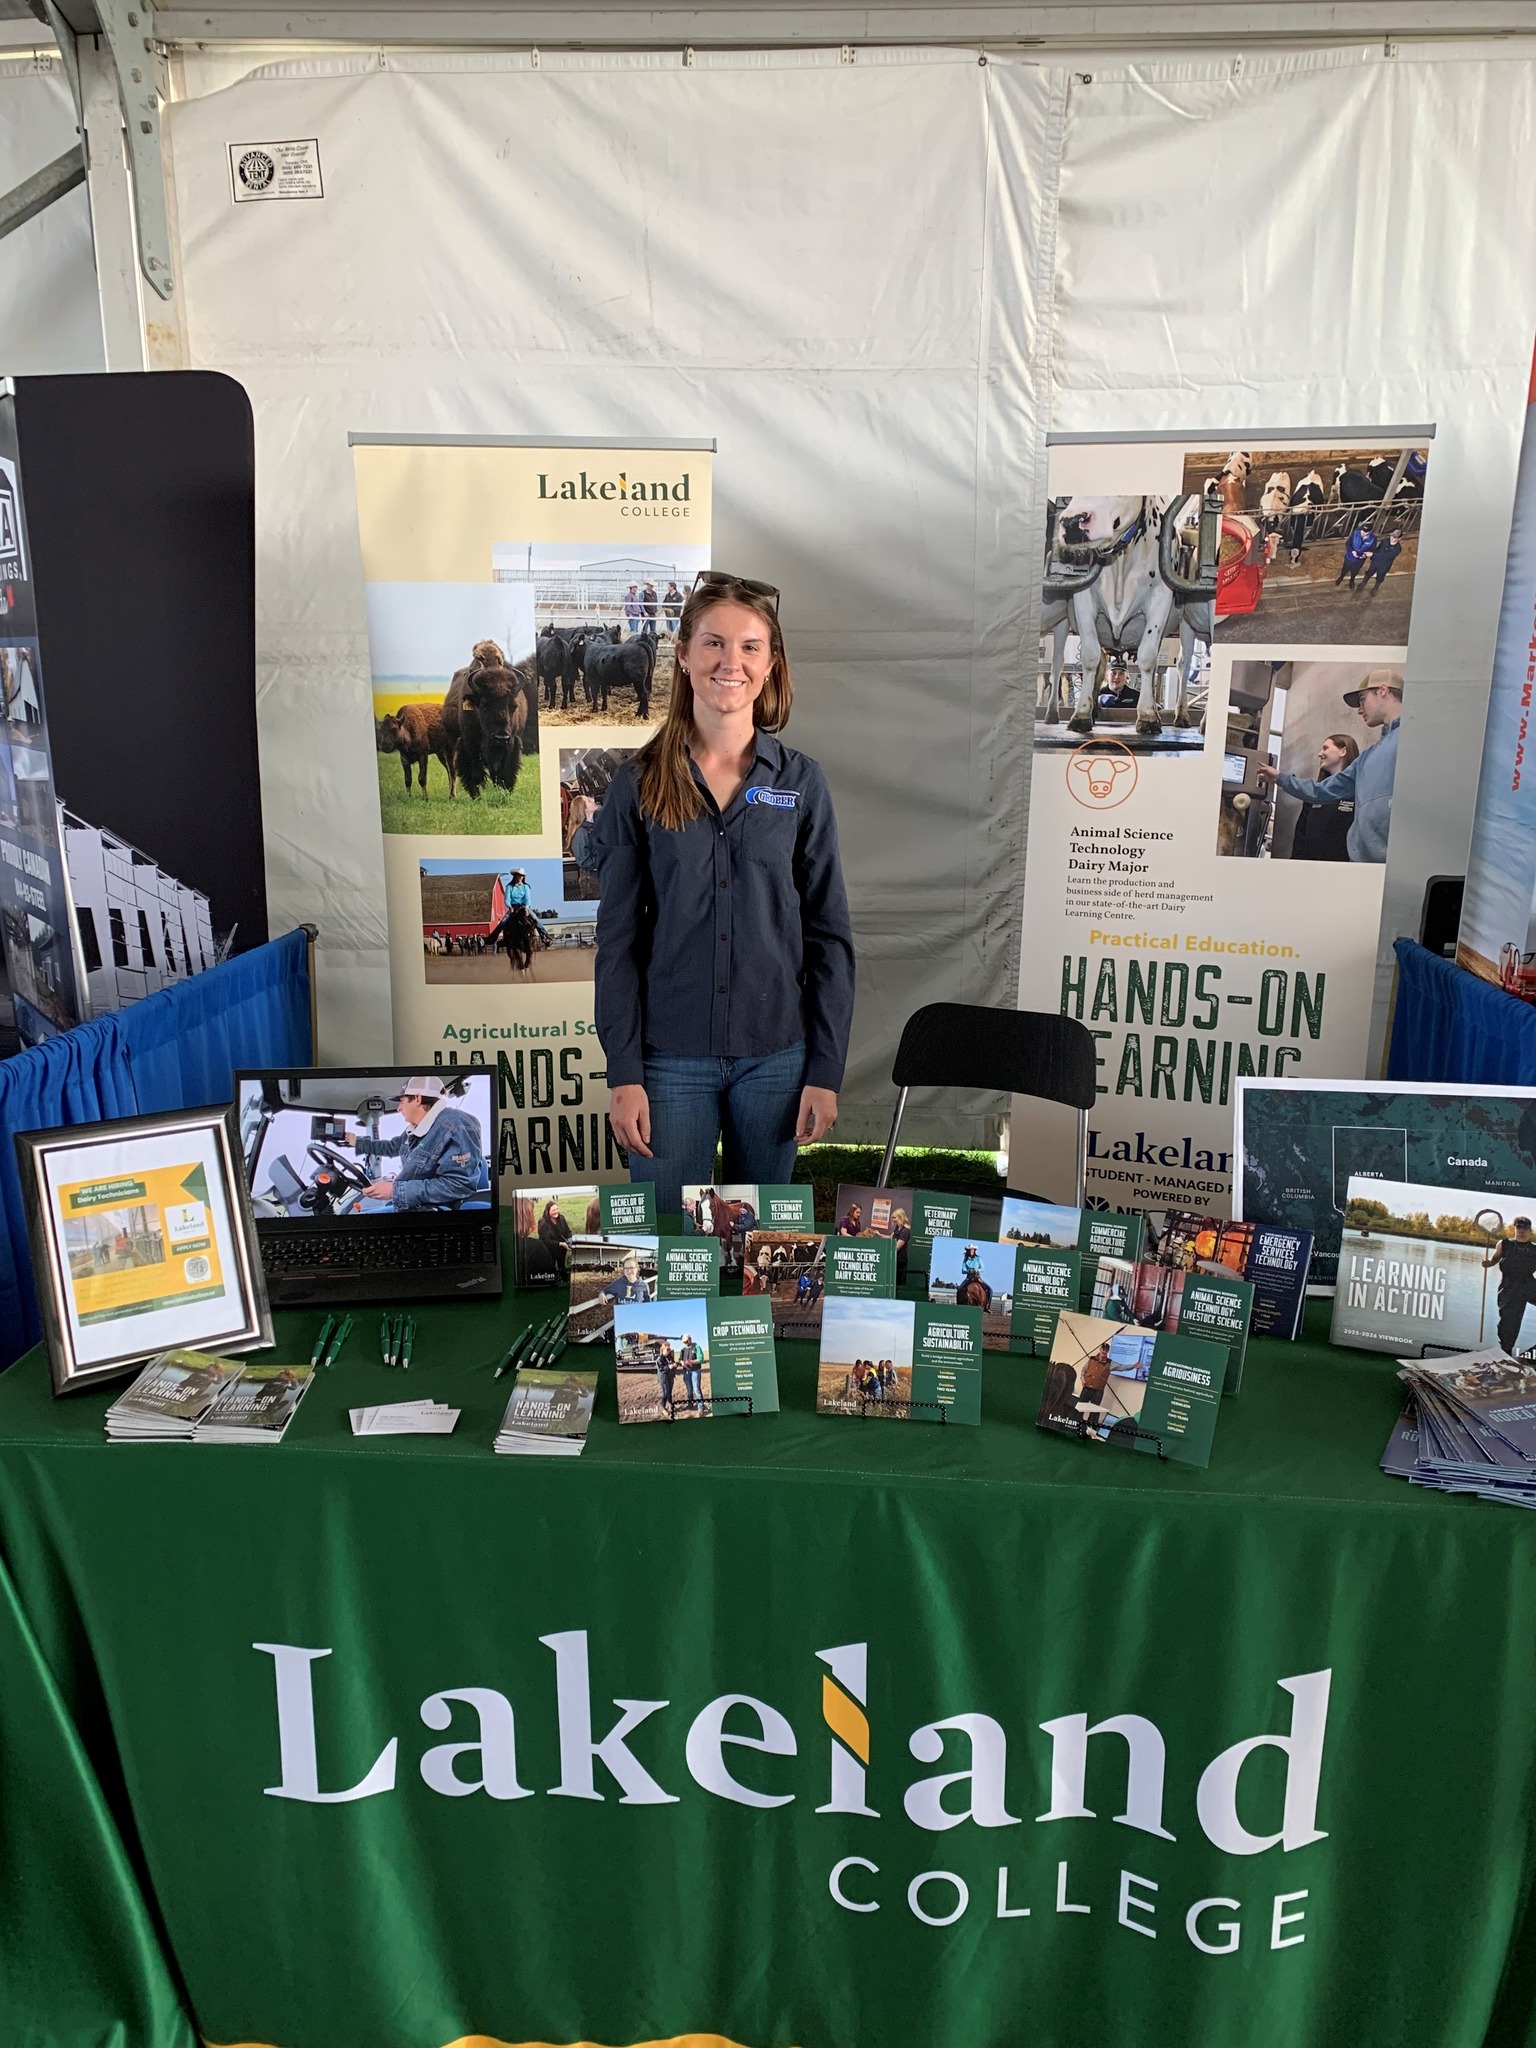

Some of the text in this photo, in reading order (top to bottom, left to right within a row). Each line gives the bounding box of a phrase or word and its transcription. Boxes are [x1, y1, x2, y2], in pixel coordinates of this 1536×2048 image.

[239, 151, 274, 168] ADVANCED
[248, 171, 266, 179] TENT
[537, 471, 692, 502] Lakeland
[620, 506, 691, 518] COLLEGE
[1070, 826, 1174, 841] Animal Science
[1069, 842, 1146, 858] Technology
[1068, 858, 1149, 875] Dairy Major
[1067, 875, 1175, 889] Learn the production and
[1066, 886, 1213, 902] business side of herd management
[1065, 897, 1186, 914] in our state-of-the-art Dairy
[1065, 908, 1136, 921] Learning Centre.
[1089, 929, 1301, 959] Practical Education.
[1060, 955, 1326, 1040] HANDS-ON
[442, 1021, 567, 1044] Agricultural
[1447, 1156, 1488, 1168] Canada
[80, 1180, 134, 1195] WE ARE HIRING
[1153, 1175, 1224, 1194] MANAGED
[1485, 1180, 1521, 1188] MANITOBA
[77, 1188, 140, 1204] Dairy Technicians
[610, 1197, 645, 1207] BACHELOR OF
[1133, 1188, 1211, 1207] POWERED BY
[612, 1206, 645, 1216] AGRICULTURE
[771, 1203, 802, 1212] VETERINARY
[924, 1209, 957, 1220] VETERINARY
[612, 1215, 645, 1225] TECHNOLOGY
[771, 1212, 803, 1221] TECHNOLOGY
[928, 1218, 951, 1229] MEDICAL
[924, 1227, 953, 1238] ASSISTANT
[1091, 1226, 1126, 1239] COMMERCIAL
[1090, 1235, 1126, 1248] AGRICULTURE
[1259, 1235, 1301, 1251] EMERGENCY
[833, 1251, 880, 1263] ANIMAL SCIENCE
[1090, 1244, 1124, 1256] PRODUCTION
[1261, 1246, 1295, 1260] SERVICES
[665, 1253, 713, 1262] ANIMAL SCIENCE
[1255, 1254, 1298, 1271] TECHNOLOGY
[670, 1262, 708, 1271] TECHNOLOGY:
[837, 1261, 876, 1272] TECHNOLOGY:
[1022, 1263, 1072, 1278] ANIMAL SCIENCE
[669, 1272, 708, 1282] BEEF SCIENCE
[835, 1270, 877, 1282] DAIRY SCIENCE
[1026, 1273, 1066, 1287] TECHNOLOGY:
[1350, 1255, 1447, 1294] LEARNING
[1022, 1283, 1069, 1297] EQUINE SCIENCE
[1190, 1290, 1243, 1309] ANIMAL SCIENCE
[1347, 1281, 1445, 1321] IN ACTION
[1194, 1301, 1236, 1317] TECHNOLOGY:
[1183, 1309, 1244, 1330] LIVESTOCK SCIENCE
[712, 1323, 769, 1337] CROP TECHNOLOGY
[927, 1327, 970, 1340] AGRICULTURE
[1343, 1328, 1414, 1345] 2025-2026 VIEWBOOK
[922, 1337, 973, 1351] SUSTAINABILITY
[1162, 1365, 1211, 1387] AGRIBUSINESS
[135, 1386, 188, 1402] LEARNING
[144, 1378, 200, 1396] HANDS-ON
[220, 1395, 276, 1404] HANDS-ON
[516, 1400, 571, 1412] HANDS-ON
[823, 1398, 857, 1408] Lakeland
[214, 1403, 270, 1411] LEARNING
[514, 1408, 566, 1419] LEARNING
[624, 1405, 659, 1416] Lakeland
[251, 1629, 1333, 1856] Lakeland
[828, 1856, 1311, 1956] COLLEGE
